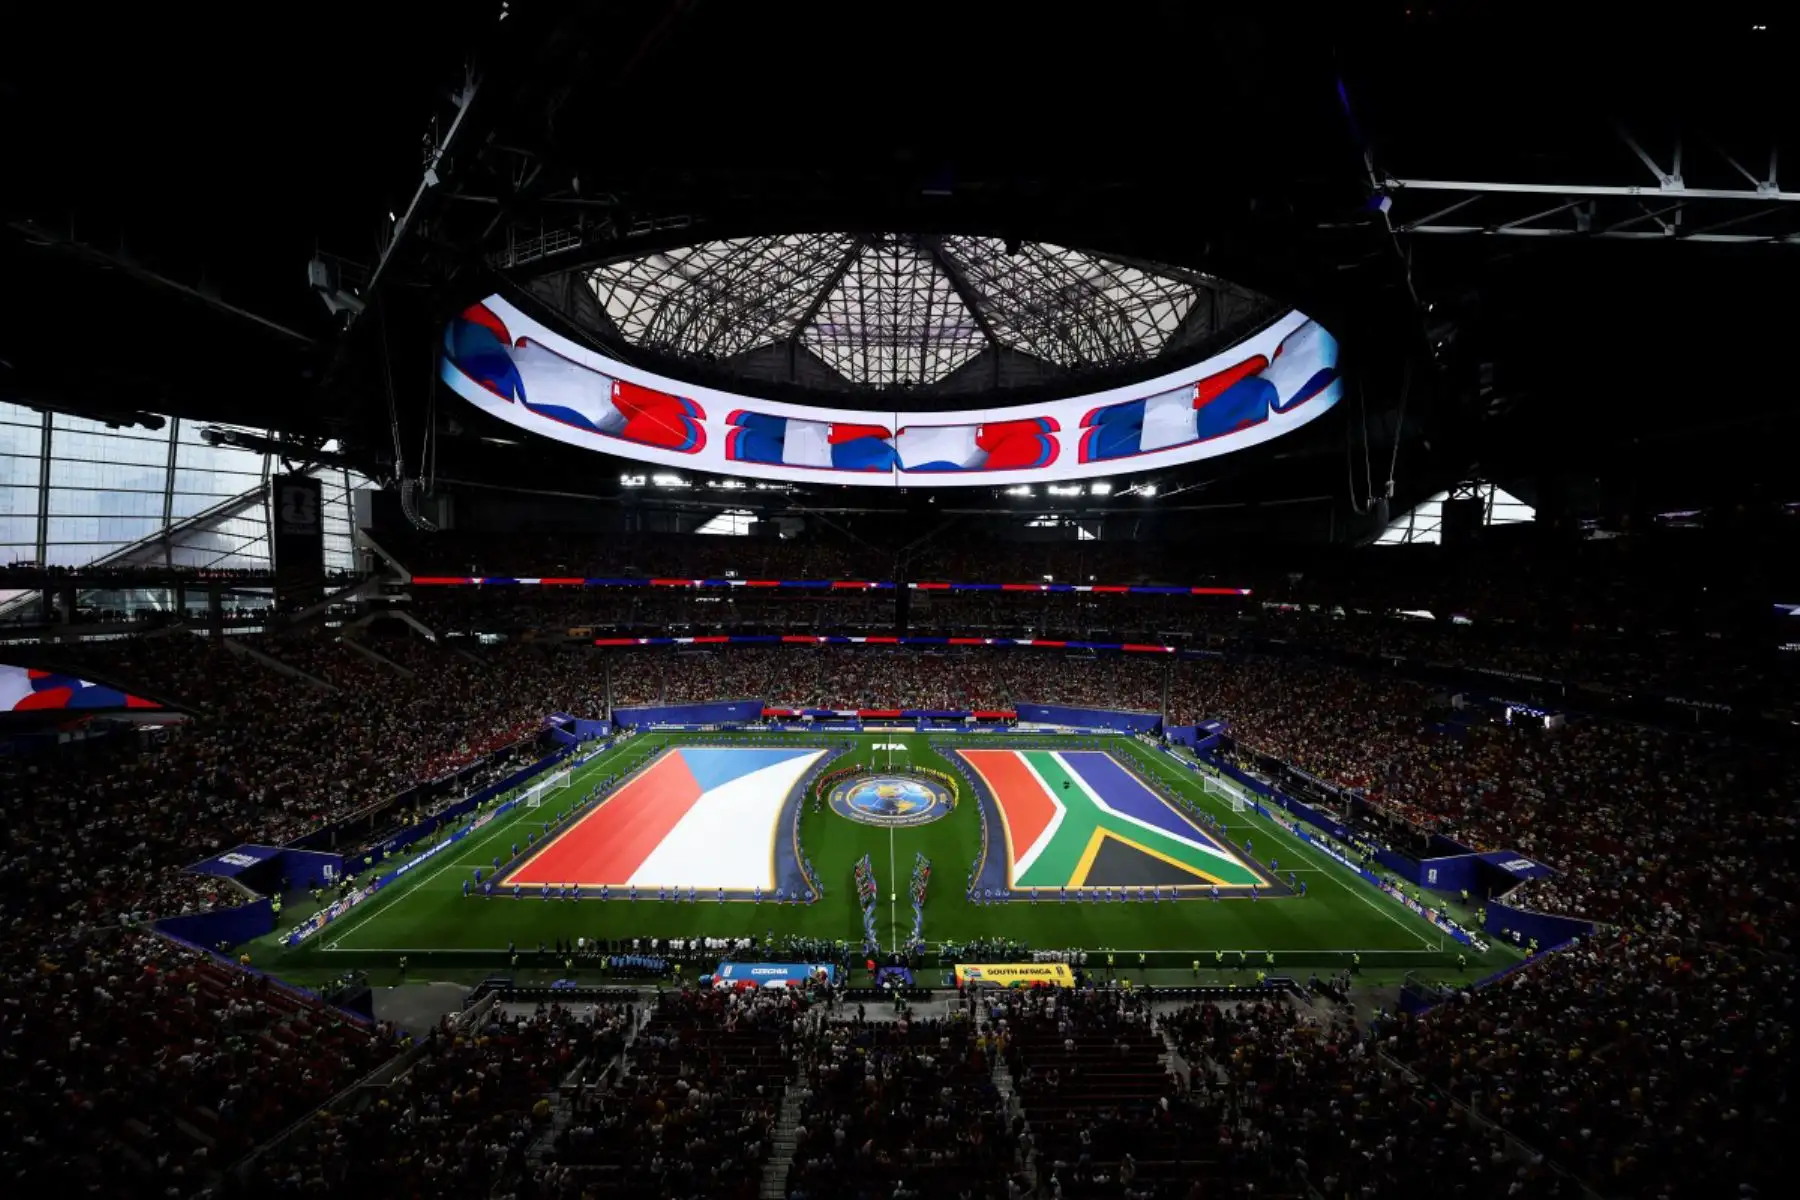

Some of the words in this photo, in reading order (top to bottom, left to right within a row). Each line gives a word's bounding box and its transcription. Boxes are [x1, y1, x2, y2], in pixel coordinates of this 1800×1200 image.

[872, 743, 908, 751] FIFA
[987, 968, 1018, 976] SOUTH
[1019, 968, 1052, 976] AFRICA
